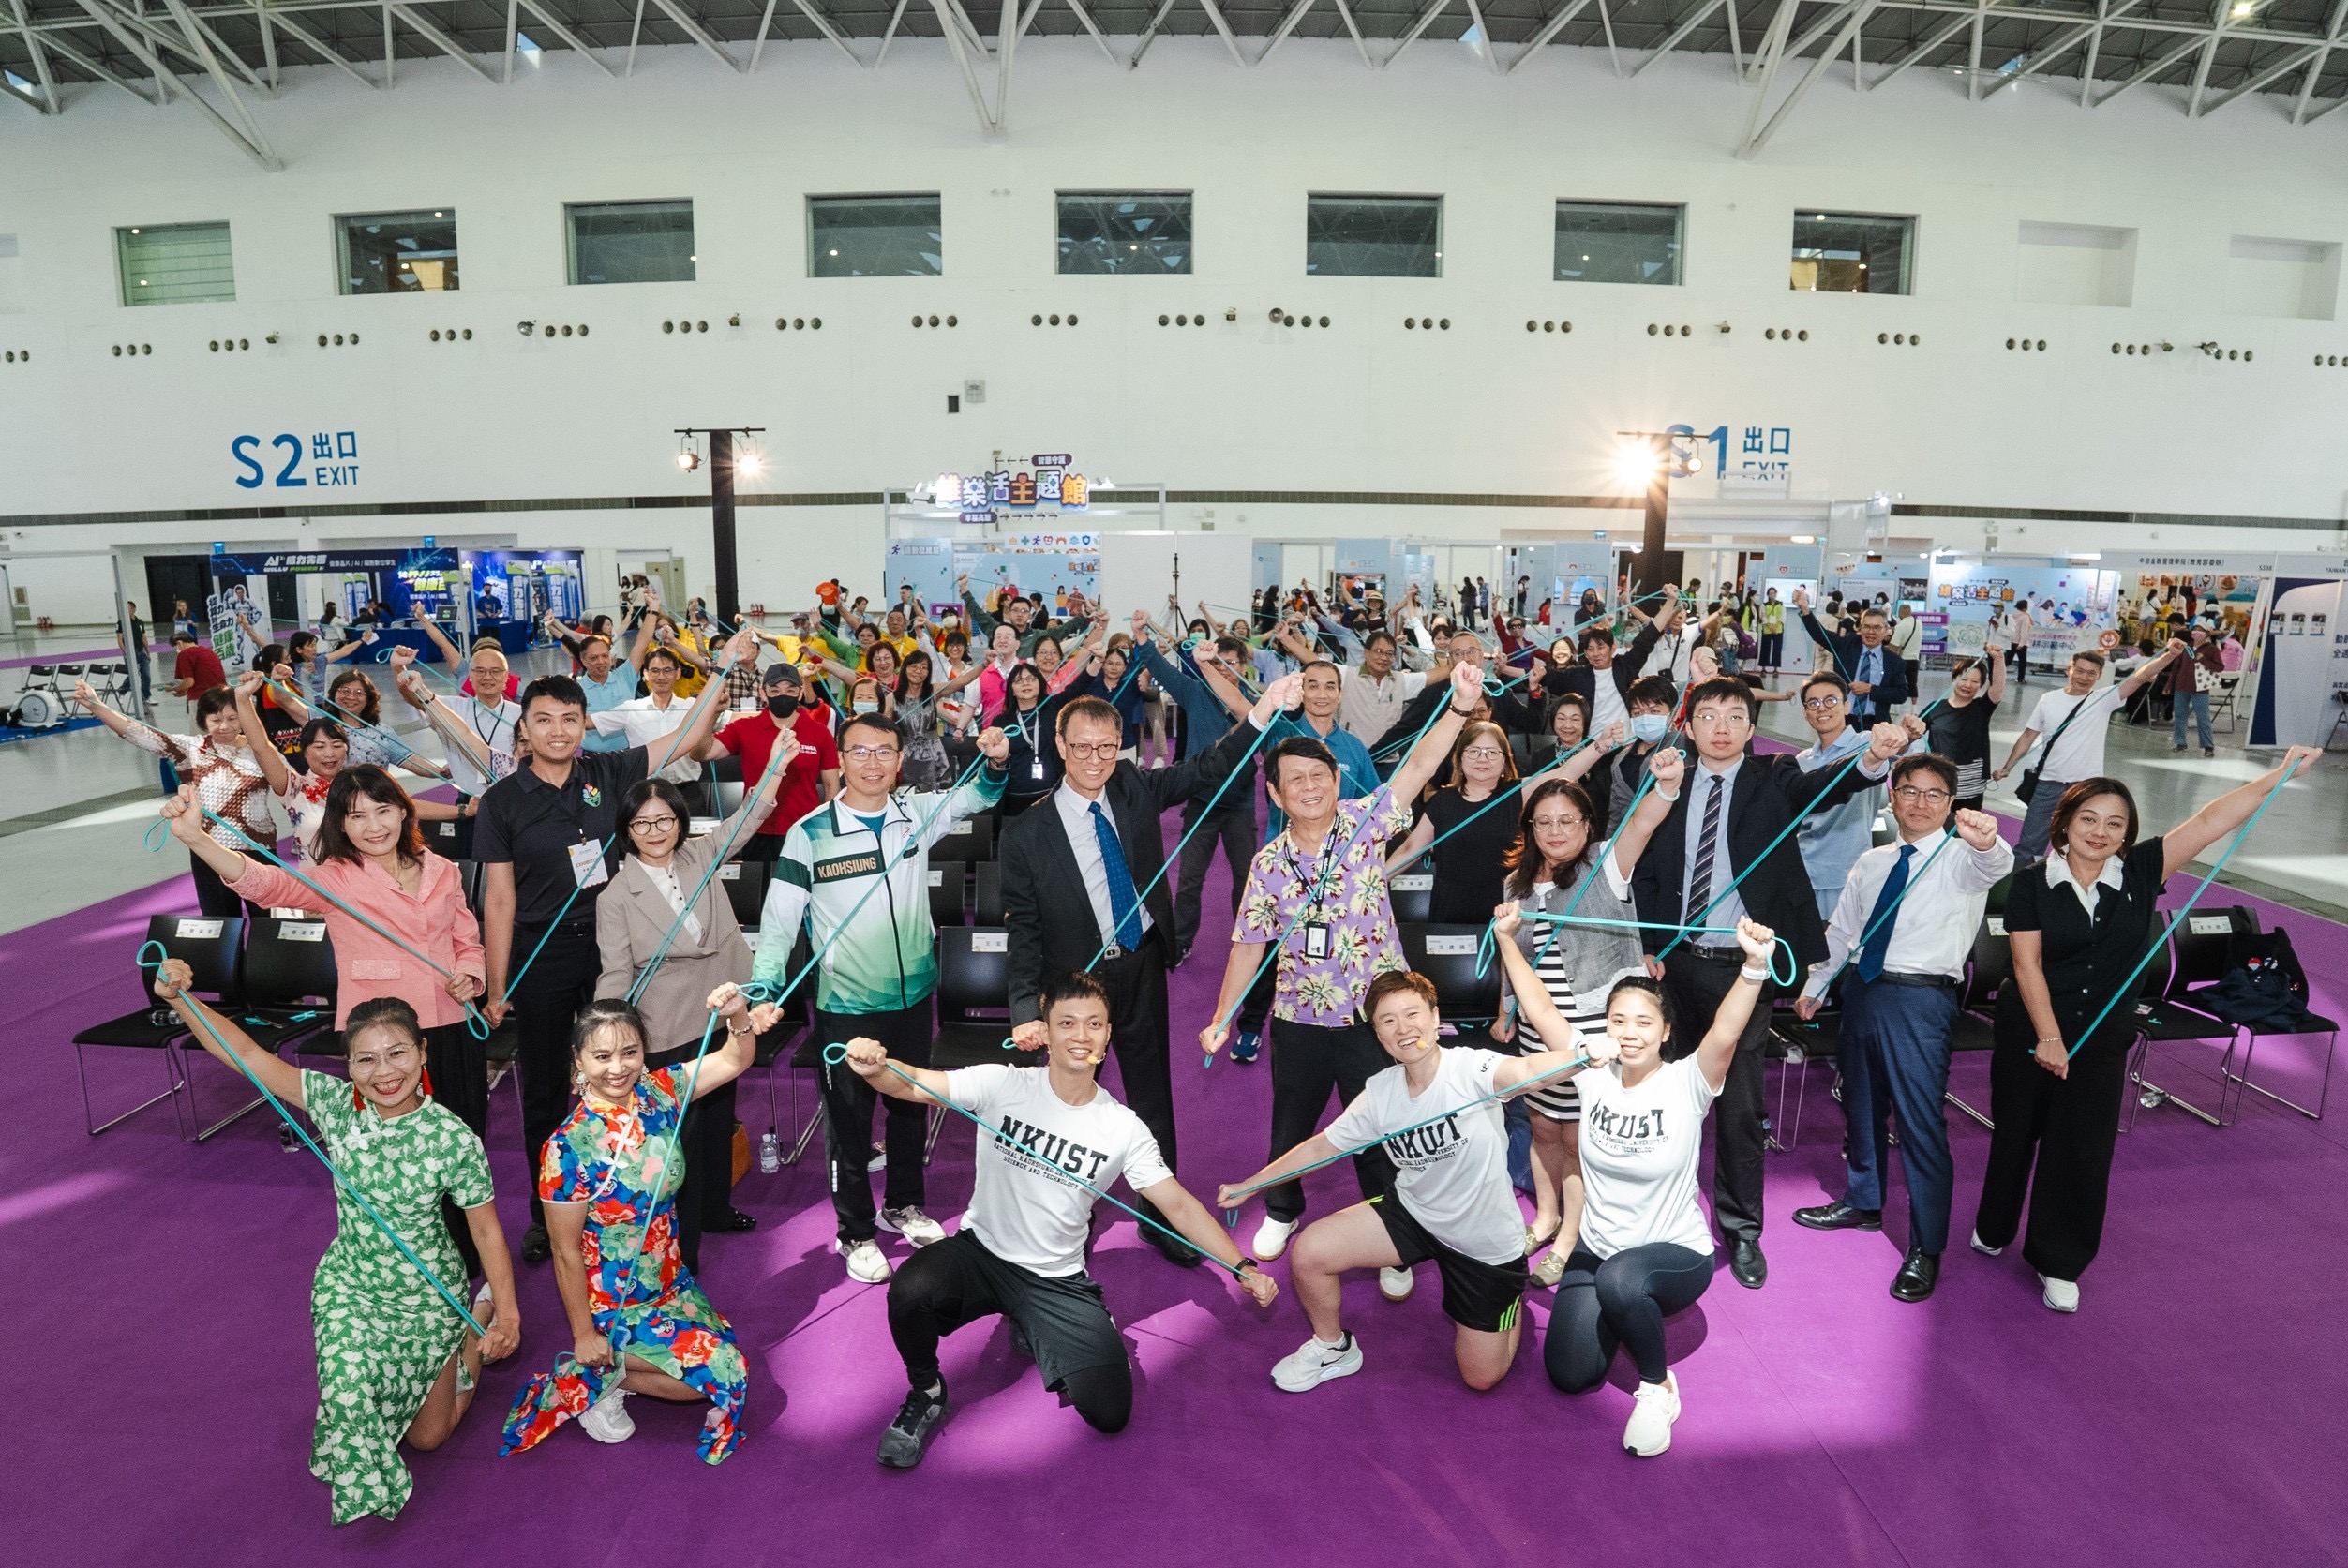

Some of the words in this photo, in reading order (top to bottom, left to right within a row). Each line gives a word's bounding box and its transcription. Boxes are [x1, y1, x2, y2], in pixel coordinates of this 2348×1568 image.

[312, 431, 357, 459] 出口
[1743, 426, 1790, 454] 出口
[232, 433, 307, 488] S2
[316, 466, 359, 485] EXIT
[212, 617, 233, 633] 生命力
[213, 629, 233, 647] 健康
[817, 857, 877, 878] KAOHSIUNG
[994, 1142, 1018, 1159] NATIONAL
[995, 1115, 1109, 1179] NKUST
[1003, 1156, 1027, 1171] SCIENCE
